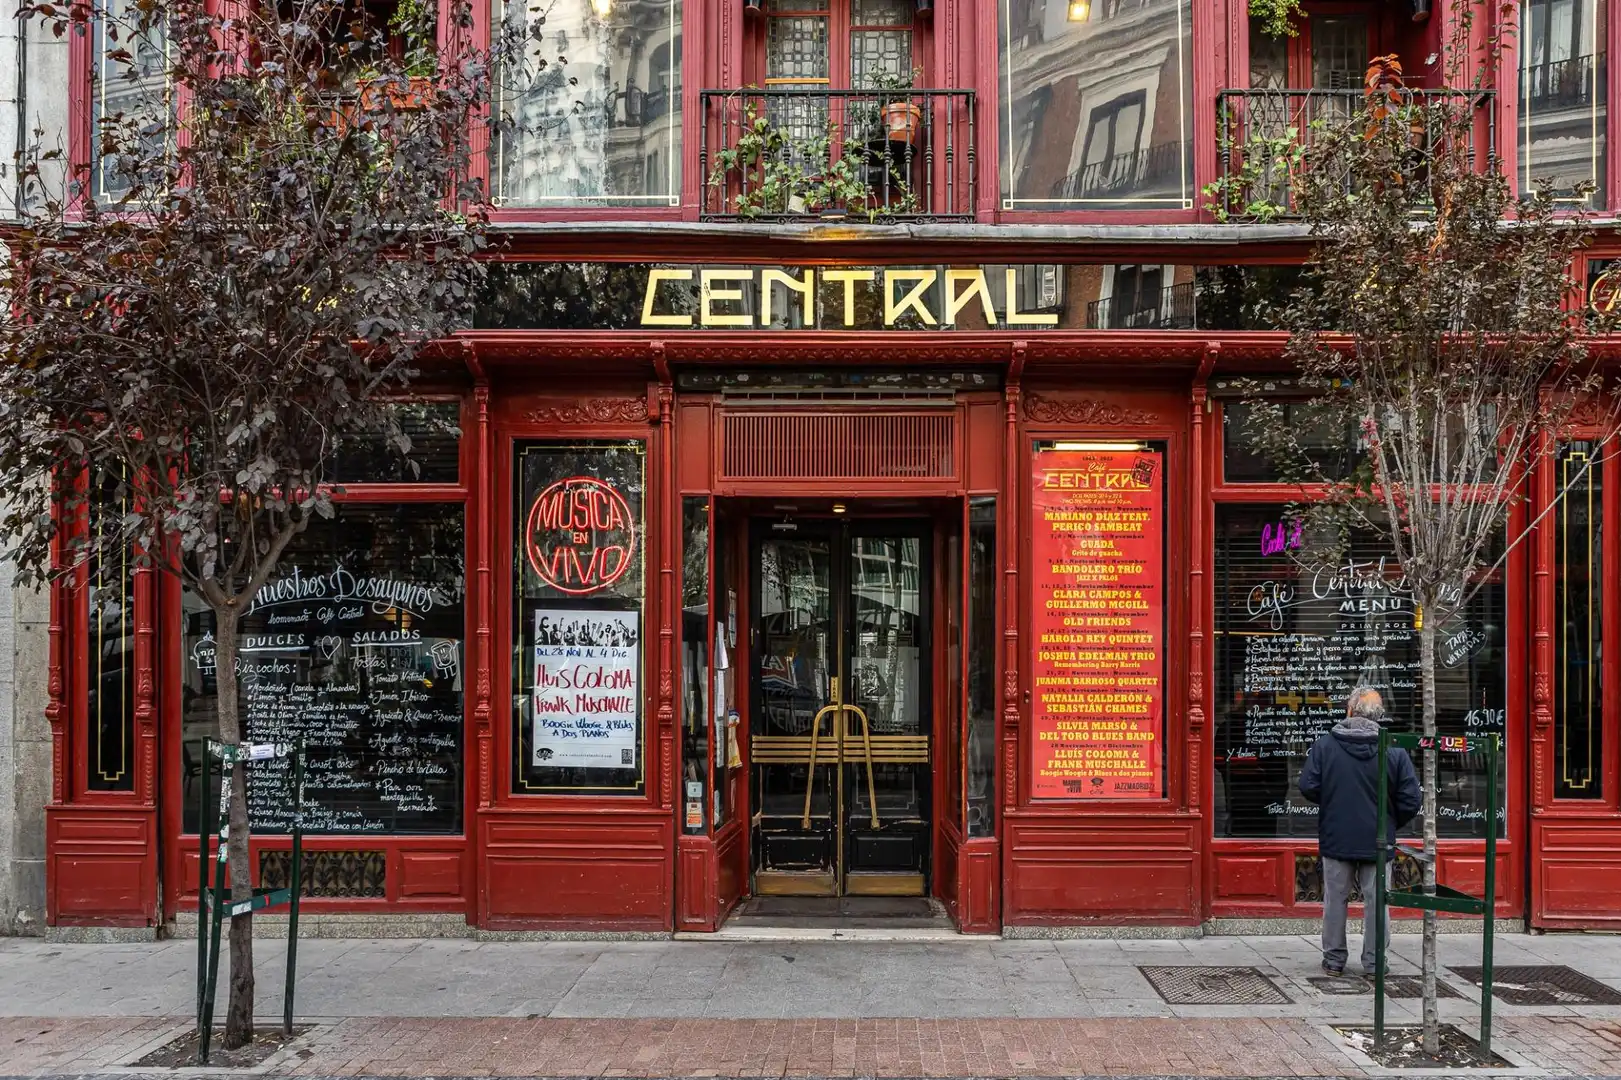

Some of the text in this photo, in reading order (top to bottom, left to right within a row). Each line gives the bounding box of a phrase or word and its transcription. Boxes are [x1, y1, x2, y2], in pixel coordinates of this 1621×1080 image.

[640, 269, 1059, 326] CENTRAL
[1045, 512, 1093, 521] MARIANO
[1096, 511, 1121, 521] DÍAZ
[1053, 522, 1143, 532] PERICO SAMBEAT
[573, 532, 588, 544] EN
[1081, 540, 1114, 549] GUADA
[535, 545, 625, 584] VIVO
[1052, 564, 1143, 574] BANDOLERO TRÍO
[330, 563, 437, 615] Desayunos
[1053, 591, 1142, 599] CLARA CAMPOS &
[1046, 600, 1149, 609] GUILLERMO MCGILL
[1247, 581, 1295, 631] Café
[1339, 595, 1402, 612] MENÚ
[316, 606, 335, 625] Café
[337, 605, 365, 620] Central
[1064, 618, 1132, 626] OLD FRIENDS
[352, 628, 421, 642] SALADOS
[1041, 635, 1153, 645] HAROLD REY QUINTET
[1446, 627, 1474, 650] TAPAS
[1039, 652, 1156, 661] JOSHUA EDELMAN TRIO
[1054, 661, 1100, 669] Remembering
[1036, 677, 1071, 686] JUANMA
[1118, 678, 1158, 686] QUARTET
[1041, 693, 1153, 702] NATALIA CALDERÓN &
[1047, 702, 1148, 713] SEBASTIÁN CHAMES
[1057, 720, 1138, 730] SILVIA MARSÓ &
[1040, 732, 1155, 740] DEL TORO BLUES BAND
[1445, 737, 1464, 748] U2
[1055, 748, 1139, 759] LLUÍS COLOMA &
[1048, 760, 1146, 769] FRANK MUSCHALLE
